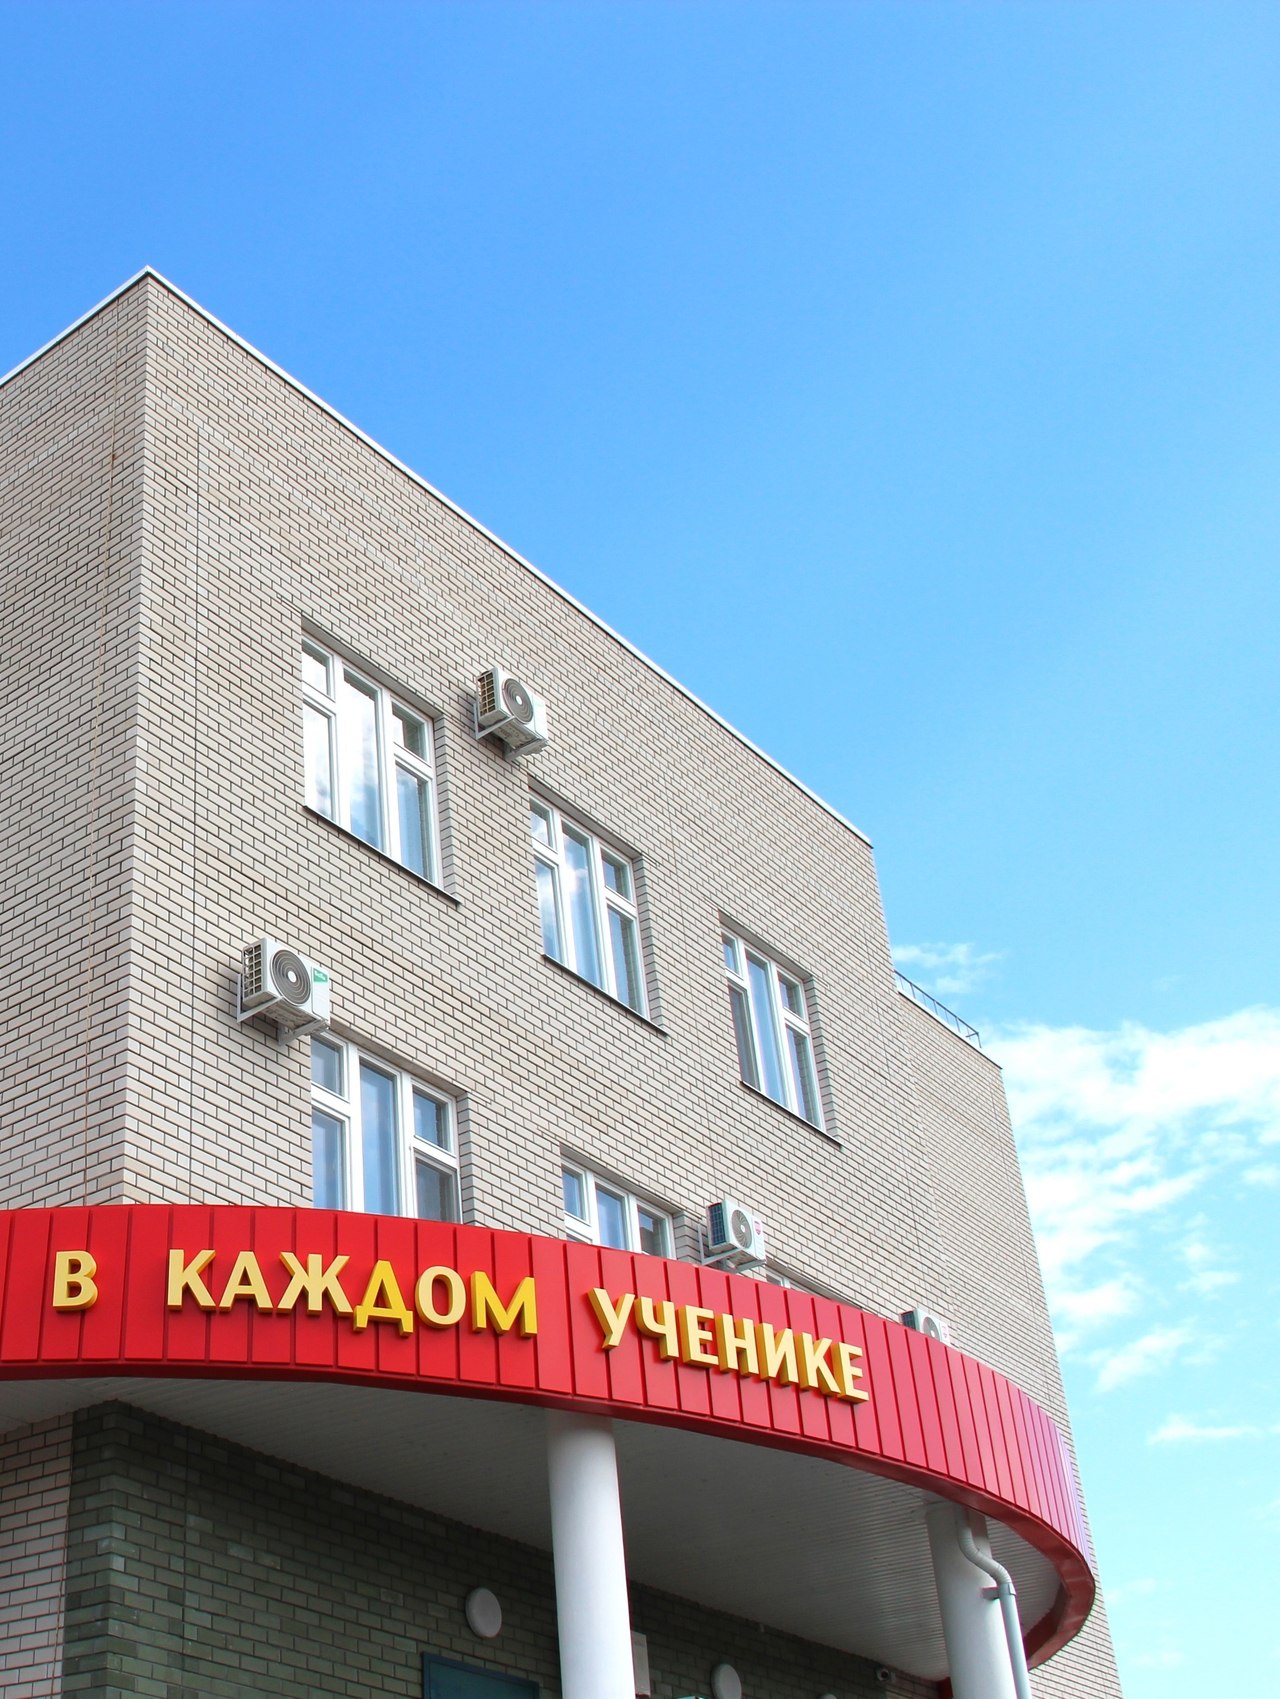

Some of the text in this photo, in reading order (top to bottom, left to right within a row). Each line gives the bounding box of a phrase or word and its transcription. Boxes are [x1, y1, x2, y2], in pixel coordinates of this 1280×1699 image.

[52, 1250, 98, 1312] В
[167, 1249, 538, 1337] КАЖДОМ
[588, 1287, 869, 1403] УЧЕНИКЕ
